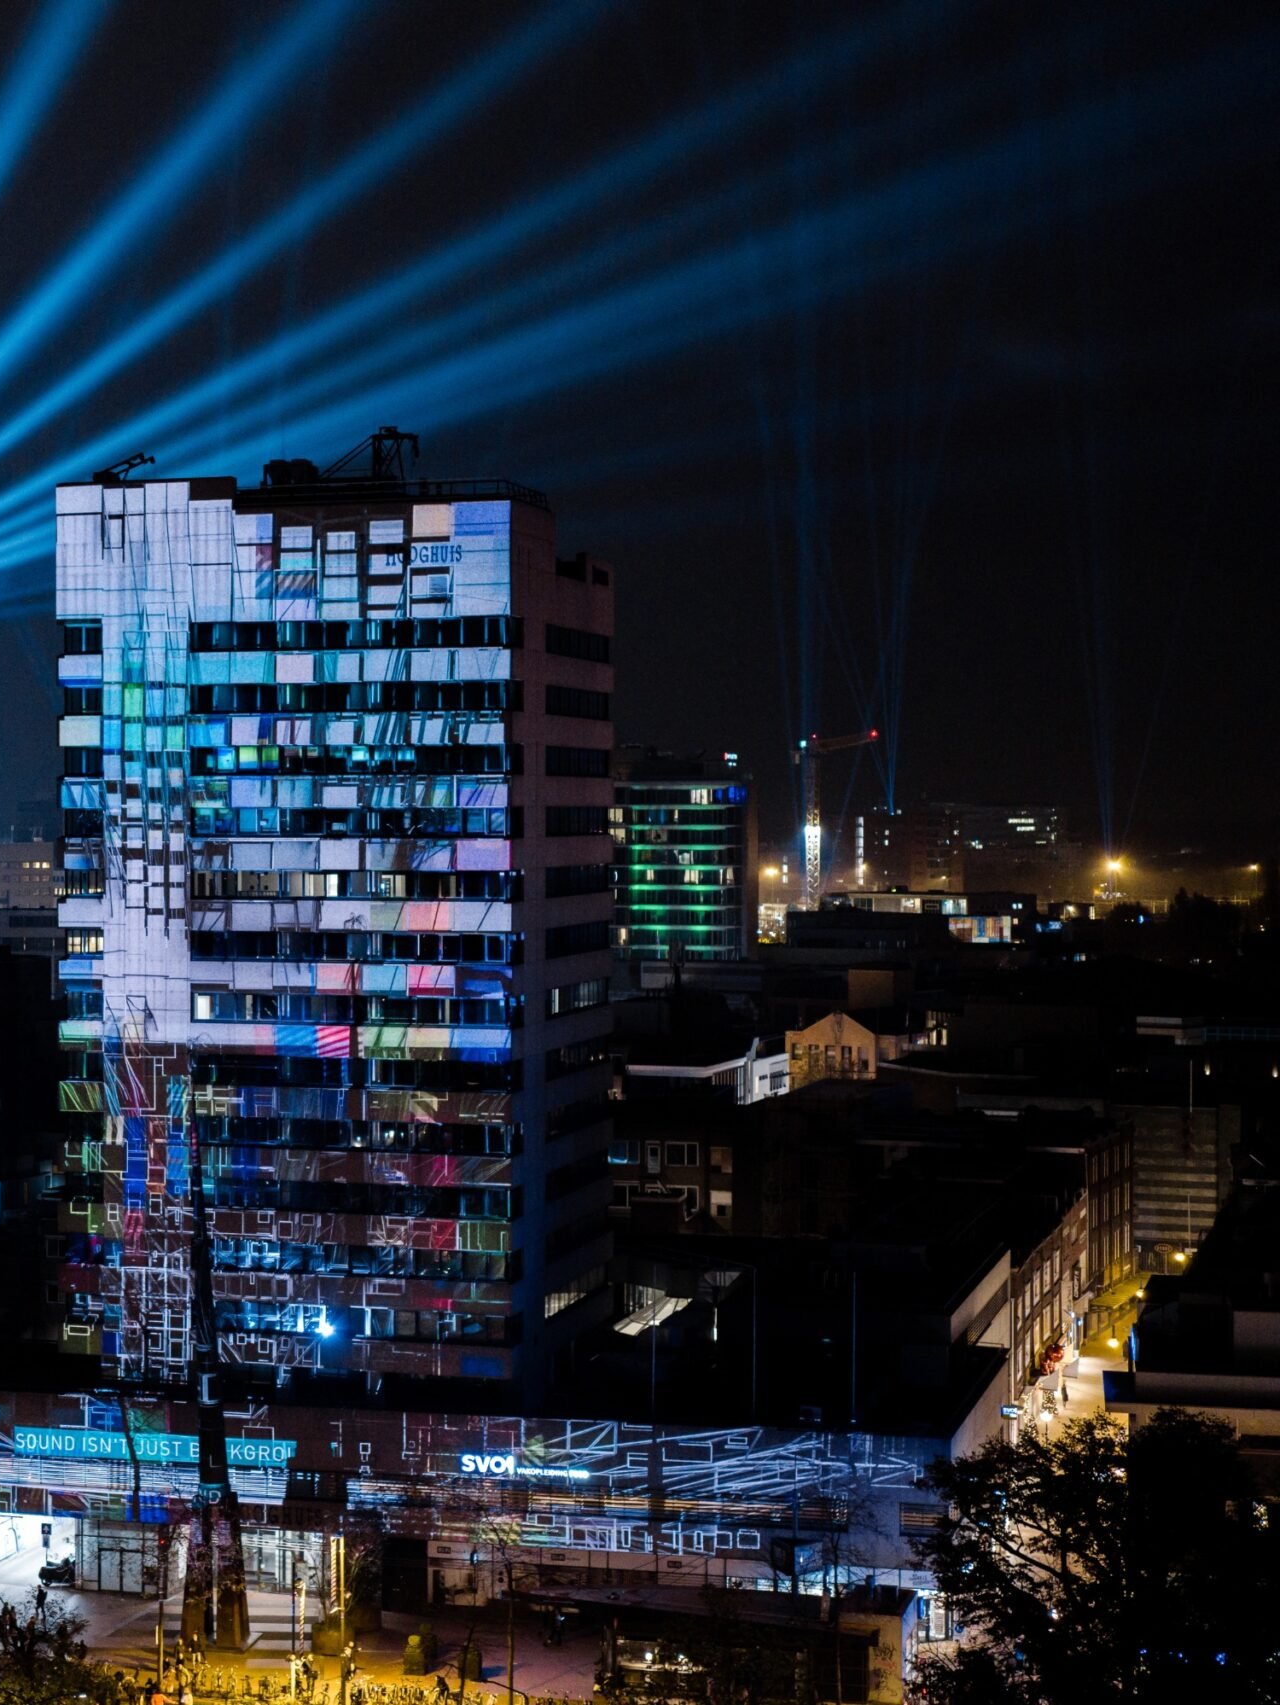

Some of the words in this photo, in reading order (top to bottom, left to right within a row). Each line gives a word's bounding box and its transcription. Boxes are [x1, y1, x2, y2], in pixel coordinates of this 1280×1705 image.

[15, 1433, 75, 1451] SOUND
[82, 1436, 128, 1454] ISN'T
[134, 1440, 182, 1456] JUST
